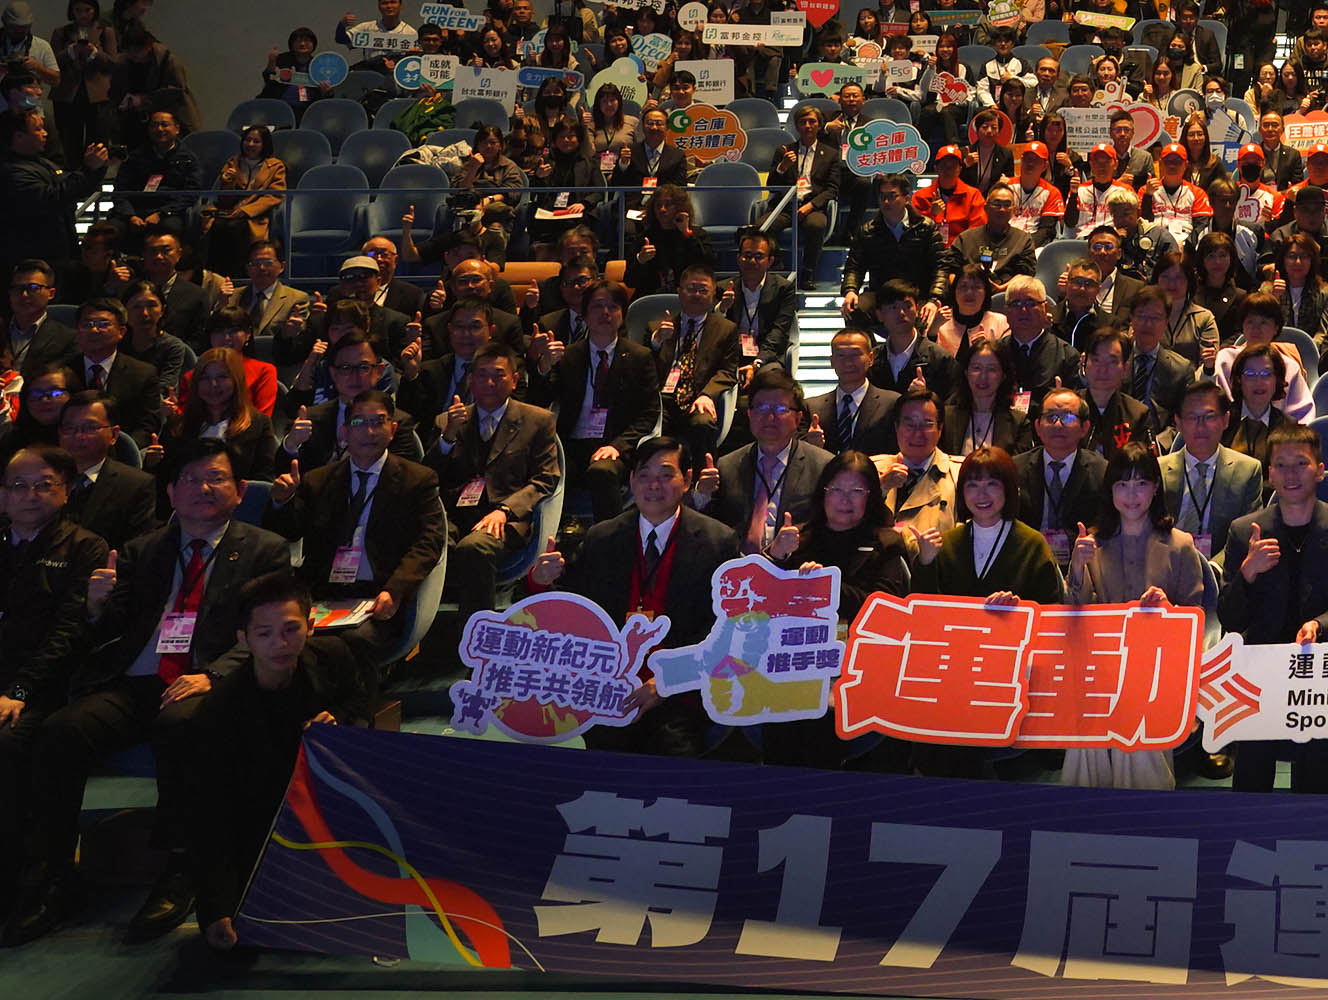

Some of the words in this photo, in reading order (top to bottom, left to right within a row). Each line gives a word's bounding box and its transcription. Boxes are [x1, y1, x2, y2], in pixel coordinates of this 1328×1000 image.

[422, 5, 449, 17] RUN
[450, 9, 467, 17] FOR
[426, 16, 478, 30] GREEN
[720, 31, 762, 41] 富邦金控
[429, 60, 451, 71] 成就
[891, 66, 911, 77] ESG
[429, 69, 450, 80] 可能
[461, 87, 508, 98] 台北富邦銀行
[695, 117, 725, 132] 合庫
[676, 133, 736, 150] 支持體育
[874, 131, 906, 147] 合庫
[857, 144, 918, 166] 支持體育
[781, 625, 829, 647] 運動
[473, 624, 617, 674] 運動新紀元
[766, 648, 839, 673] 推手獎
[841, 598, 1198, 746] 運動
[485, 661, 627, 712] 推手共領航
